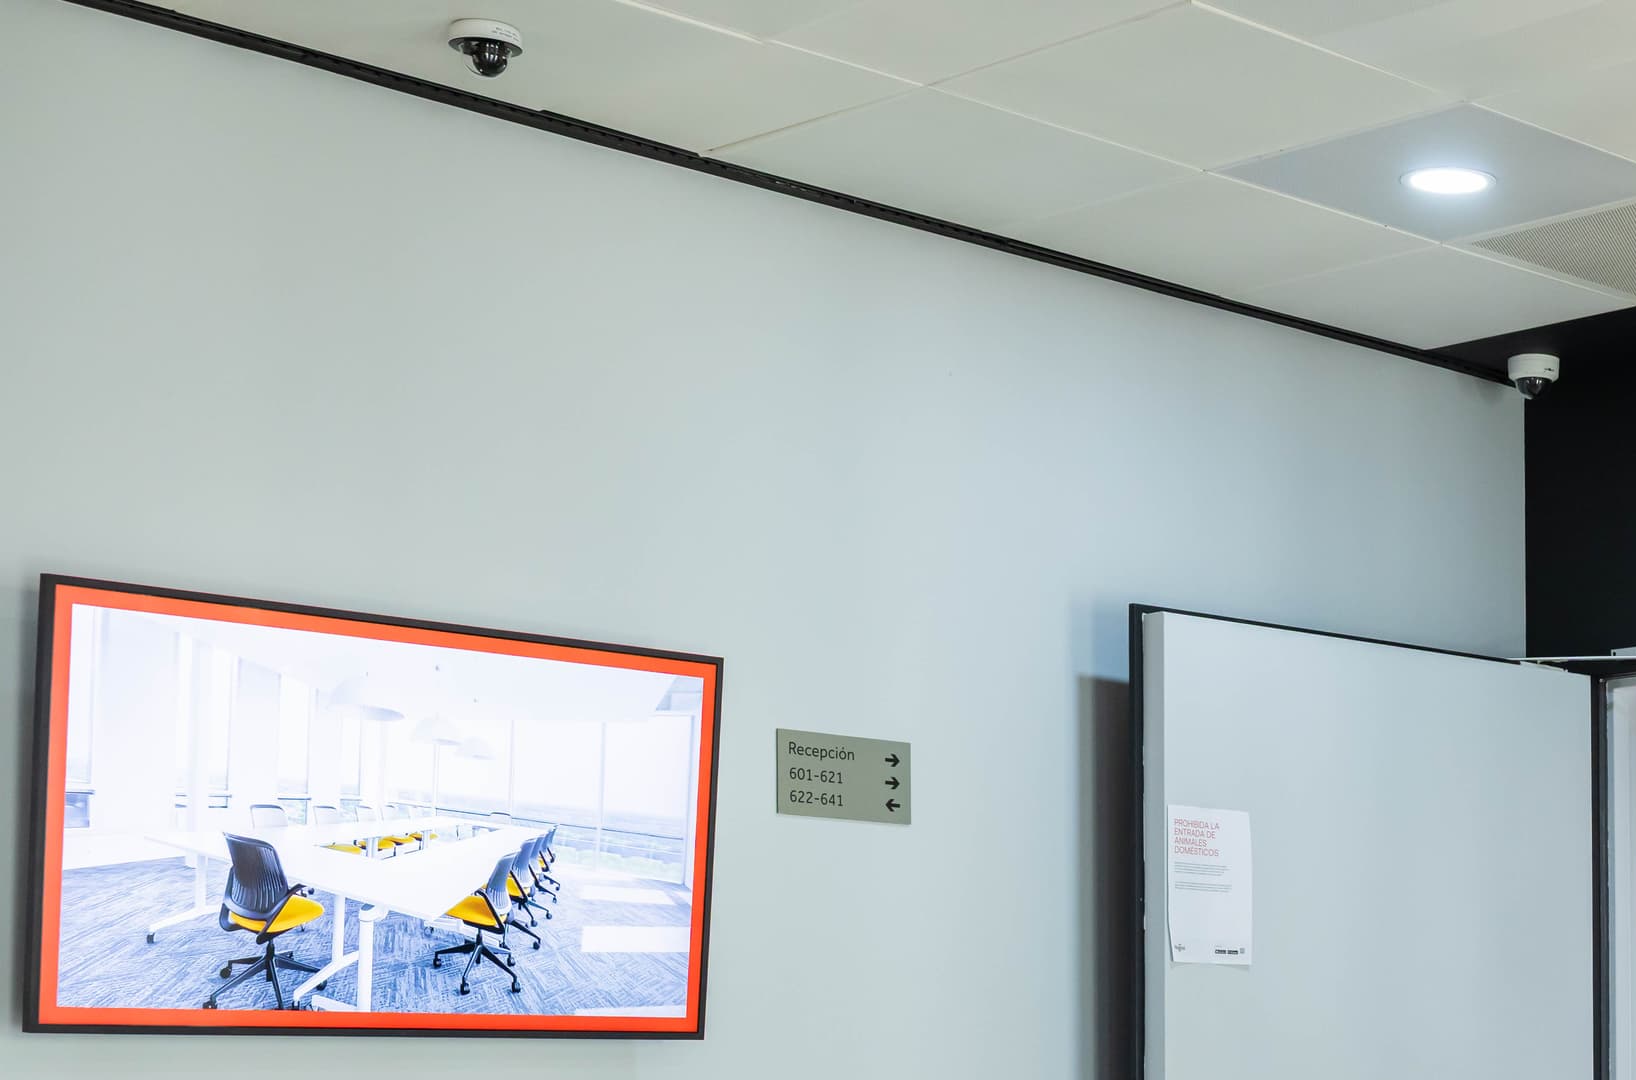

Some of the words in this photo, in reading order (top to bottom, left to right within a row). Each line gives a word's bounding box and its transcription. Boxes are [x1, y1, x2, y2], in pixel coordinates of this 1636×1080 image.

[788, 741, 855, 761] Recepción
[789, 767, 843, 784] 601-621
[789, 790, 843, 807] 622-641
[1206, 830, 1216, 839] DE
